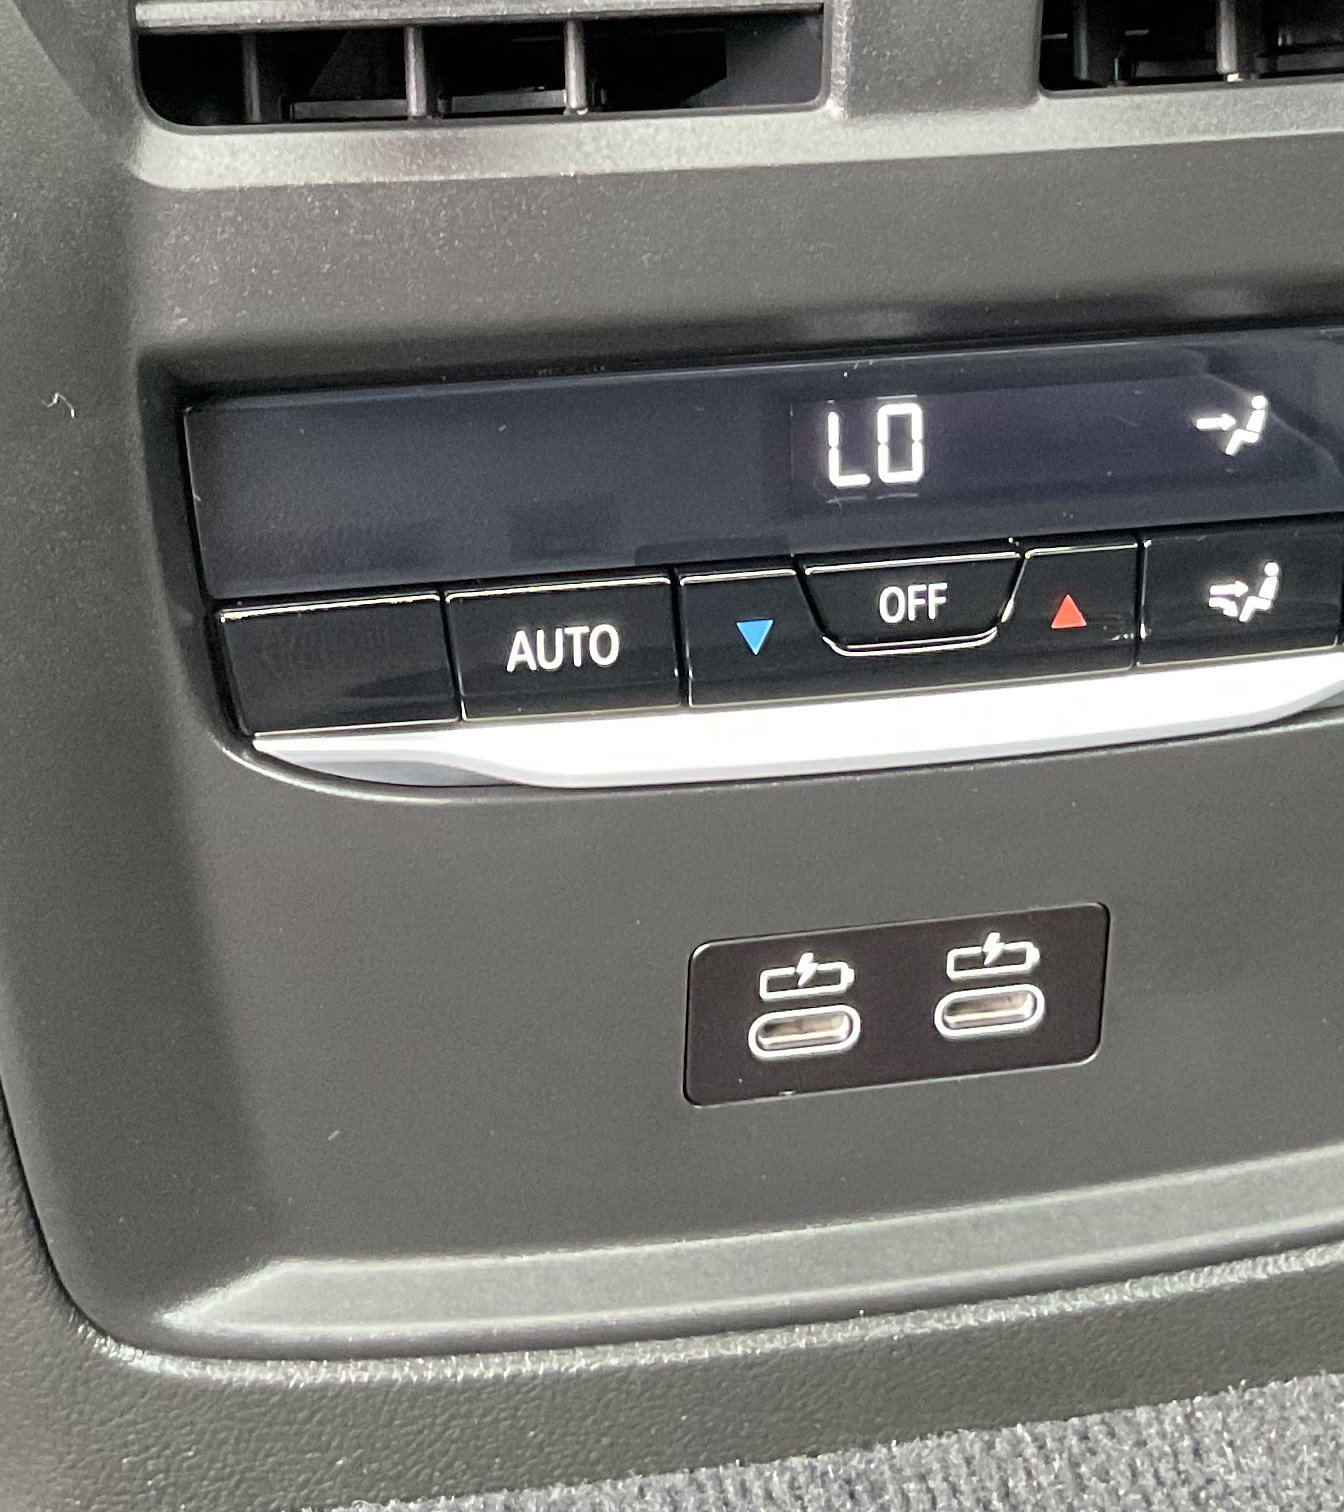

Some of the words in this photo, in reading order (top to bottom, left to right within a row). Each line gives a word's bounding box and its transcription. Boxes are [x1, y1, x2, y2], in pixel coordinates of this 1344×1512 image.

[826, 401, 925, 489] LO
[878, 581, 949, 625] OFF
[506, 619, 622, 673] AUTO
